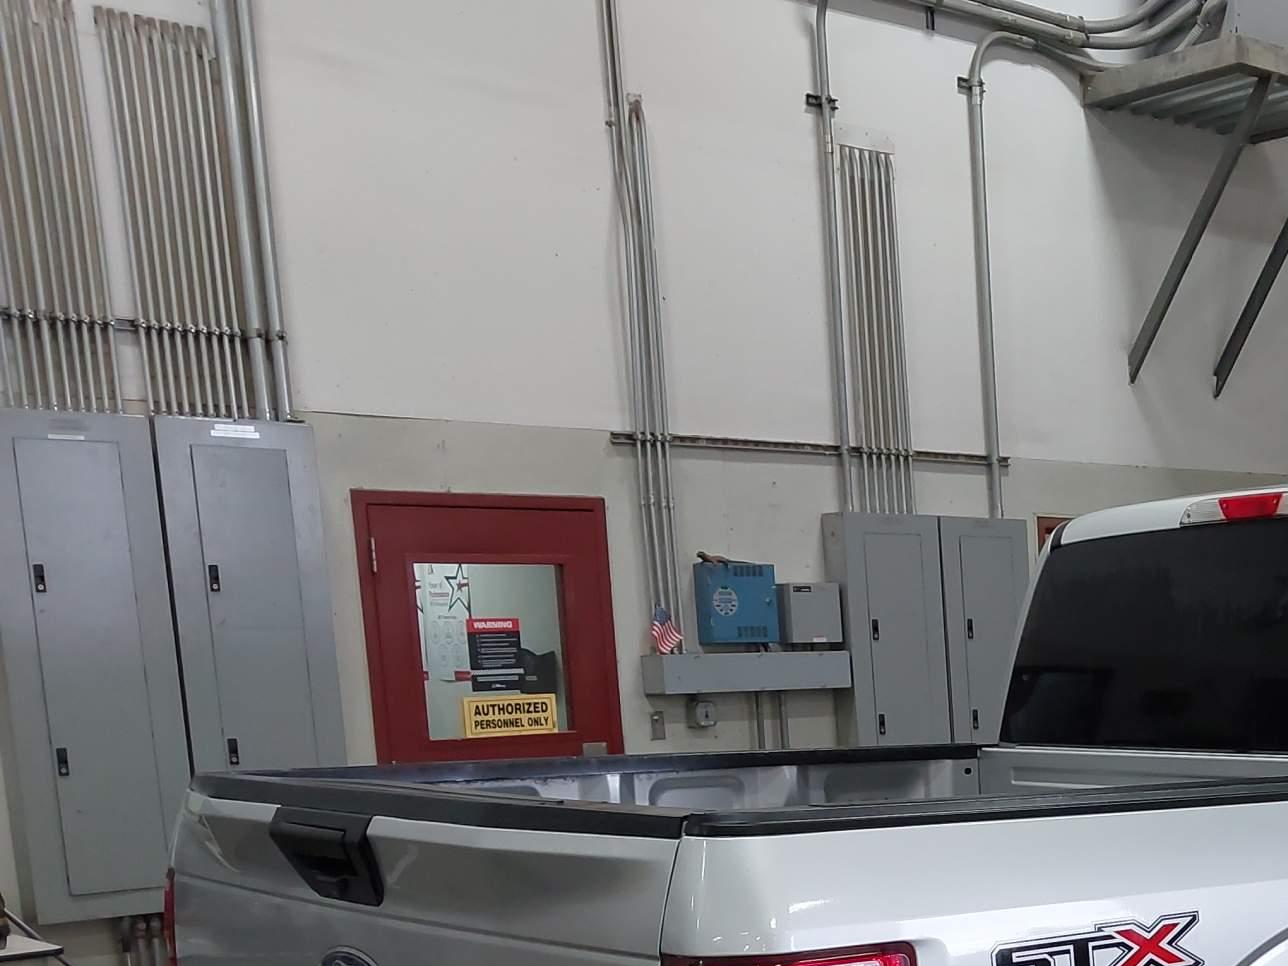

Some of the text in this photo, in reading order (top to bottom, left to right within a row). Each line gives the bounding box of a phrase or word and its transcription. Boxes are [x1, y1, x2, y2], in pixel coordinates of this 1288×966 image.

[473, 702, 549, 717] AUTHORIZED
[474, 716, 549, 730] PERSONNEL ONLY
